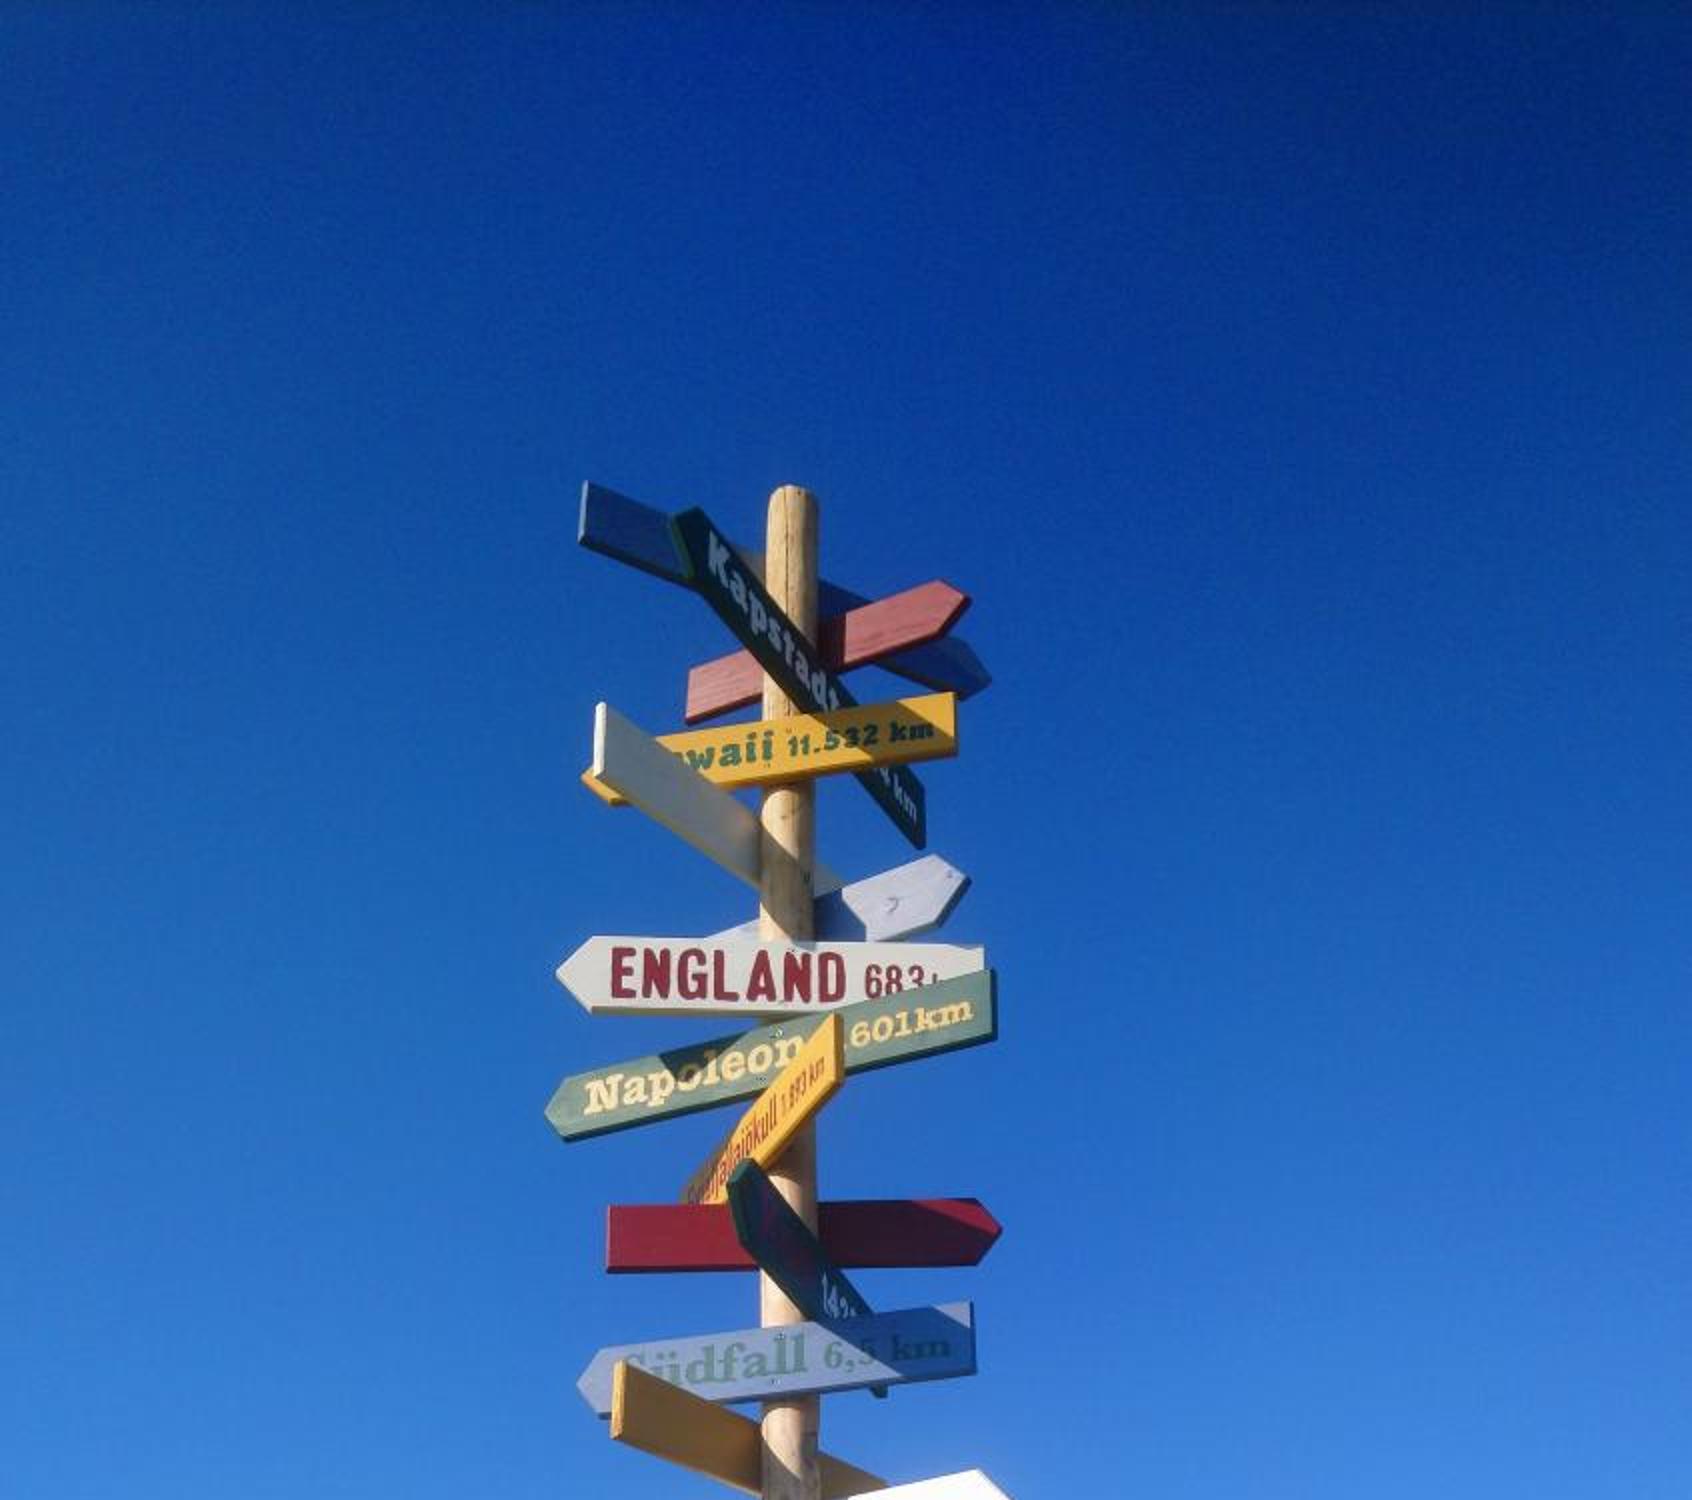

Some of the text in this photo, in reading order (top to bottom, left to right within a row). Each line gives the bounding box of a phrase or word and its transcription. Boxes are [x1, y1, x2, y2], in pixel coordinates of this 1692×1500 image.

[680, 721, 934, 769] waii 11.532 km
[611, 947, 847, 1003] ENGLAND
[584, 1035, 806, 1115] Napoleon
[892, 1335, 949, 1360] km
